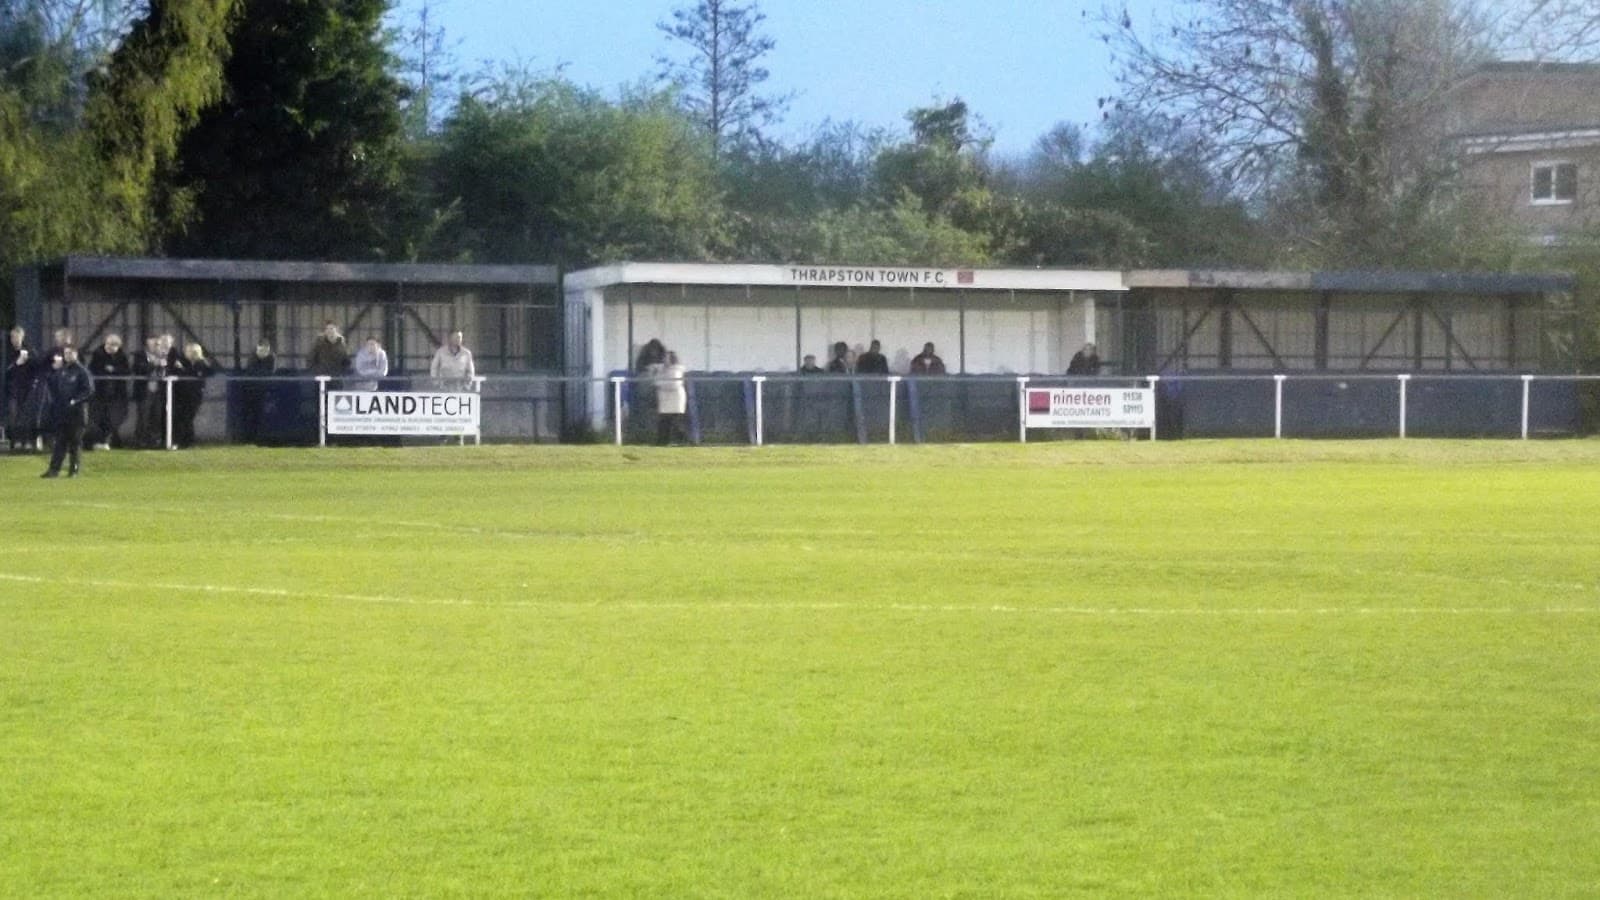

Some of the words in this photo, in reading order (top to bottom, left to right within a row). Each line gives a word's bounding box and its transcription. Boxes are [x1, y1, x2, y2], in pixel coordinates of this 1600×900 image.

[790, 268, 875, 282] THRAPSTON
[880, 270, 919, 283] TOWN
[355, 395, 471, 415] LANDTECH
[1053, 390, 1111, 405] nineteen
[1053, 407, 1111, 416] ACCOUNTANTS
